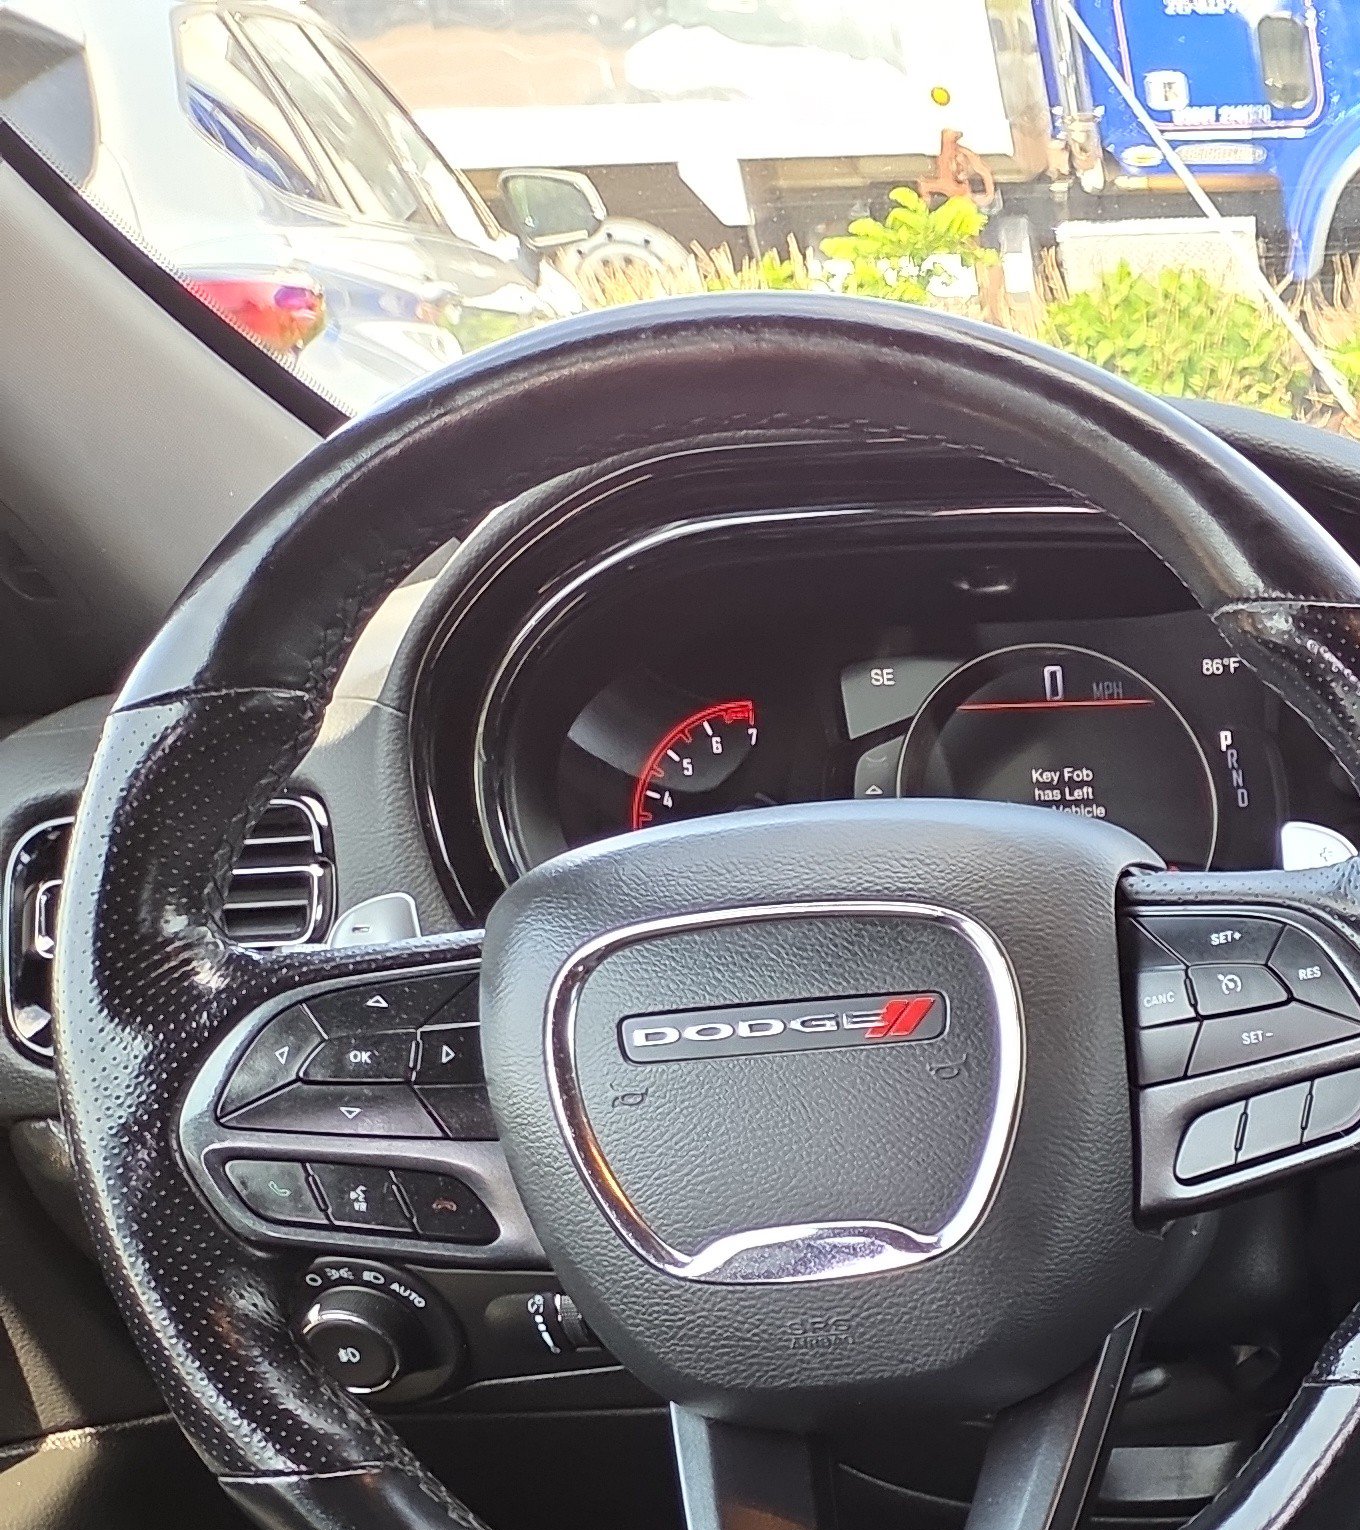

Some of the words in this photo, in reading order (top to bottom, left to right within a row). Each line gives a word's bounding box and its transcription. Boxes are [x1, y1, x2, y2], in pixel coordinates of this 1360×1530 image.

[1202, 657, 1240, 675] 86°F
[870, 668, 895, 686] SE
[1093, 681, 1123, 699] MPH
[711, 736, 722, 754] 6
[747, 727, 758, 746] 7
[1219, 730, 1232, 752] P
[682, 757, 693, 776] 5
[1227, 749, 1238, 770] R
[1031, 768, 1060, 788] Key
[1063, 767, 1094, 782] Fob
[1232, 769, 1243, 787] N
[663, 790, 673, 808] 4
[1034, 786, 1061, 801] has
[1065, 786, 1094, 801] Left
[1298, 966, 1322, 981] RES
[1143, 991, 1175, 1007] CANC
[632, 1011, 887, 1047] DODGE
[349, 1050, 372, 1064] OK
[390, 1282, 426, 1308] AUTO
